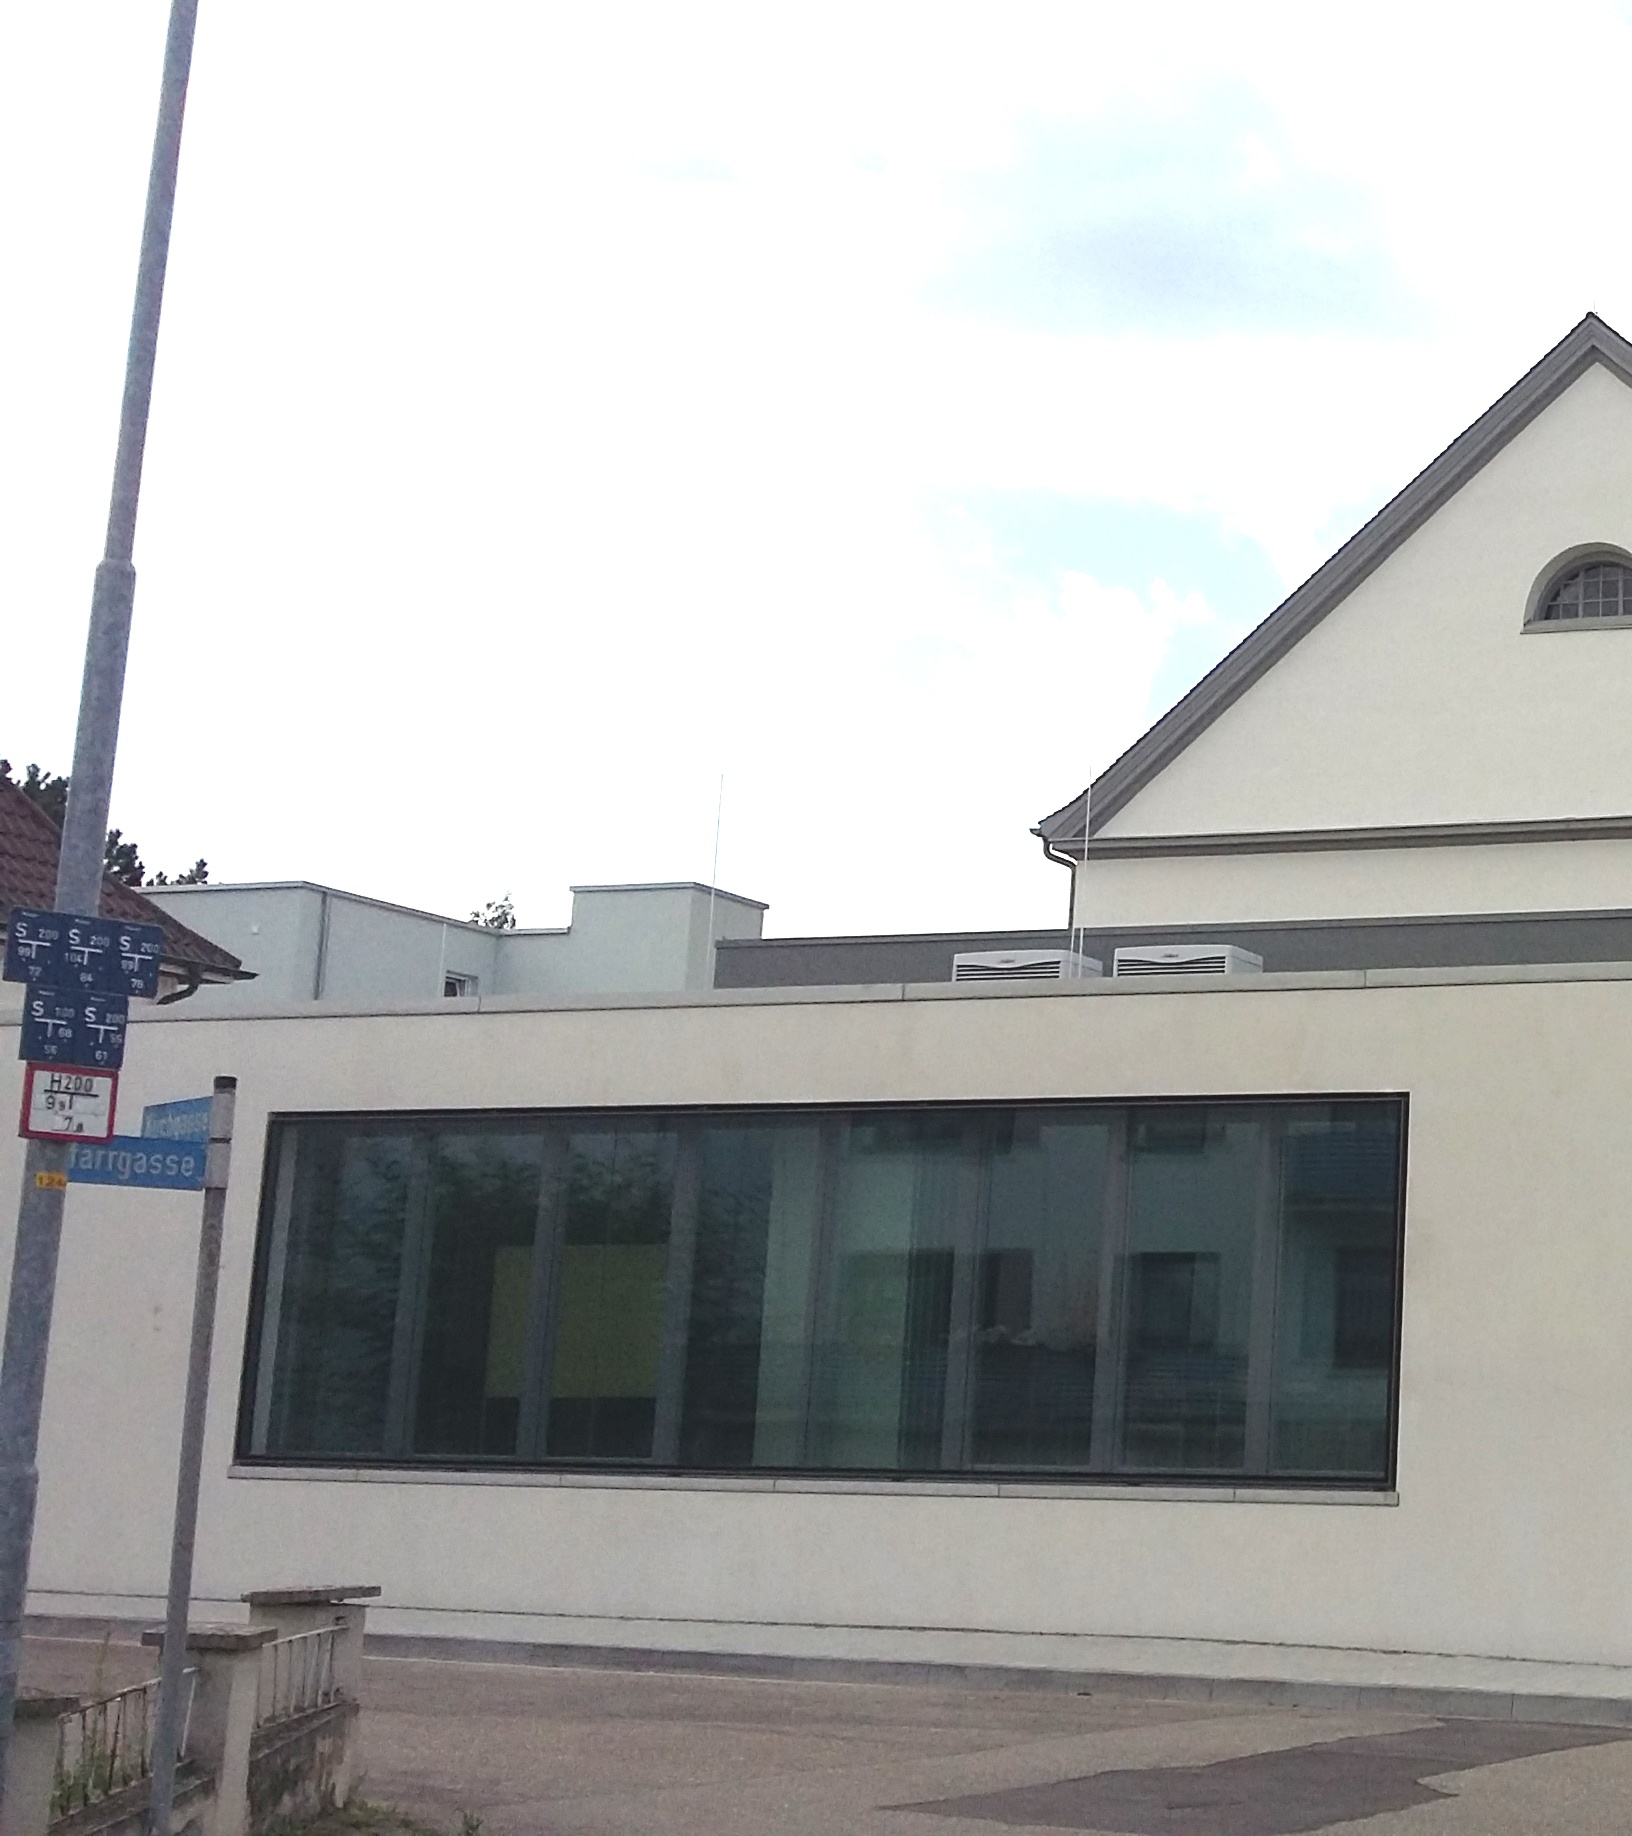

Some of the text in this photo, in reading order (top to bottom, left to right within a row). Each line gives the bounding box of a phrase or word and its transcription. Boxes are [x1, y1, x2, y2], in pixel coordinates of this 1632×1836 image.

[15, 922, 28, 938] S
[68, 928, 81, 944] S
[119, 935, 132, 951] S
[31, 1000, 44, 1017] S
[84, 1006, 97, 1022] S
[68, 1143, 196, 1180] farrgasse
